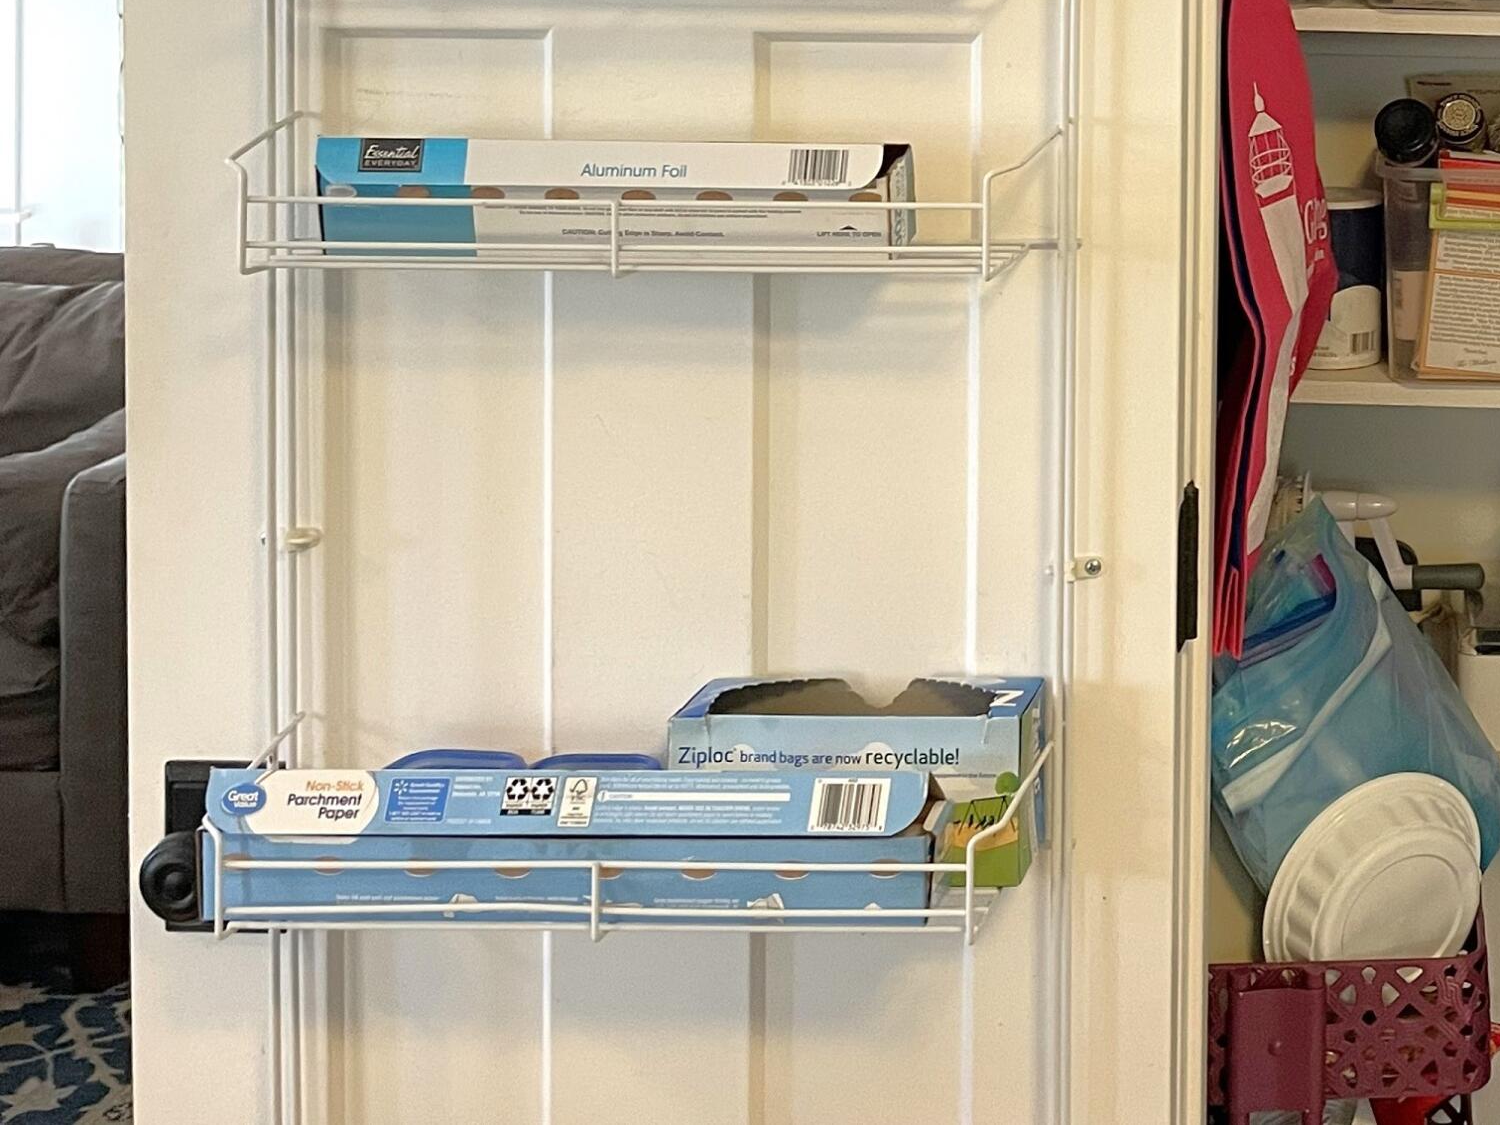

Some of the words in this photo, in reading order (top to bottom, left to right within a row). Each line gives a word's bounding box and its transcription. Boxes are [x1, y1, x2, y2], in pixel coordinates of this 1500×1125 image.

[364, 144, 420, 159] Essential
[364, 159, 417, 167] EVERYDAY
[581, 163, 657, 178] Aluminum
[661, 164, 687, 178] Foil
[678, 747, 735, 767] Ziploc
[740, 750, 778, 764] brand
[779, 751, 808, 767] bags
[812, 754, 833, 765] are
[835, 754, 862, 765] now
[865, 748, 960, 769] recyclable!
[306, 780, 365, 792] Non-Stick
[228, 790, 259, 803] Great
[287, 793, 362, 806] Parchment
[318, 807, 360, 821] Paper
